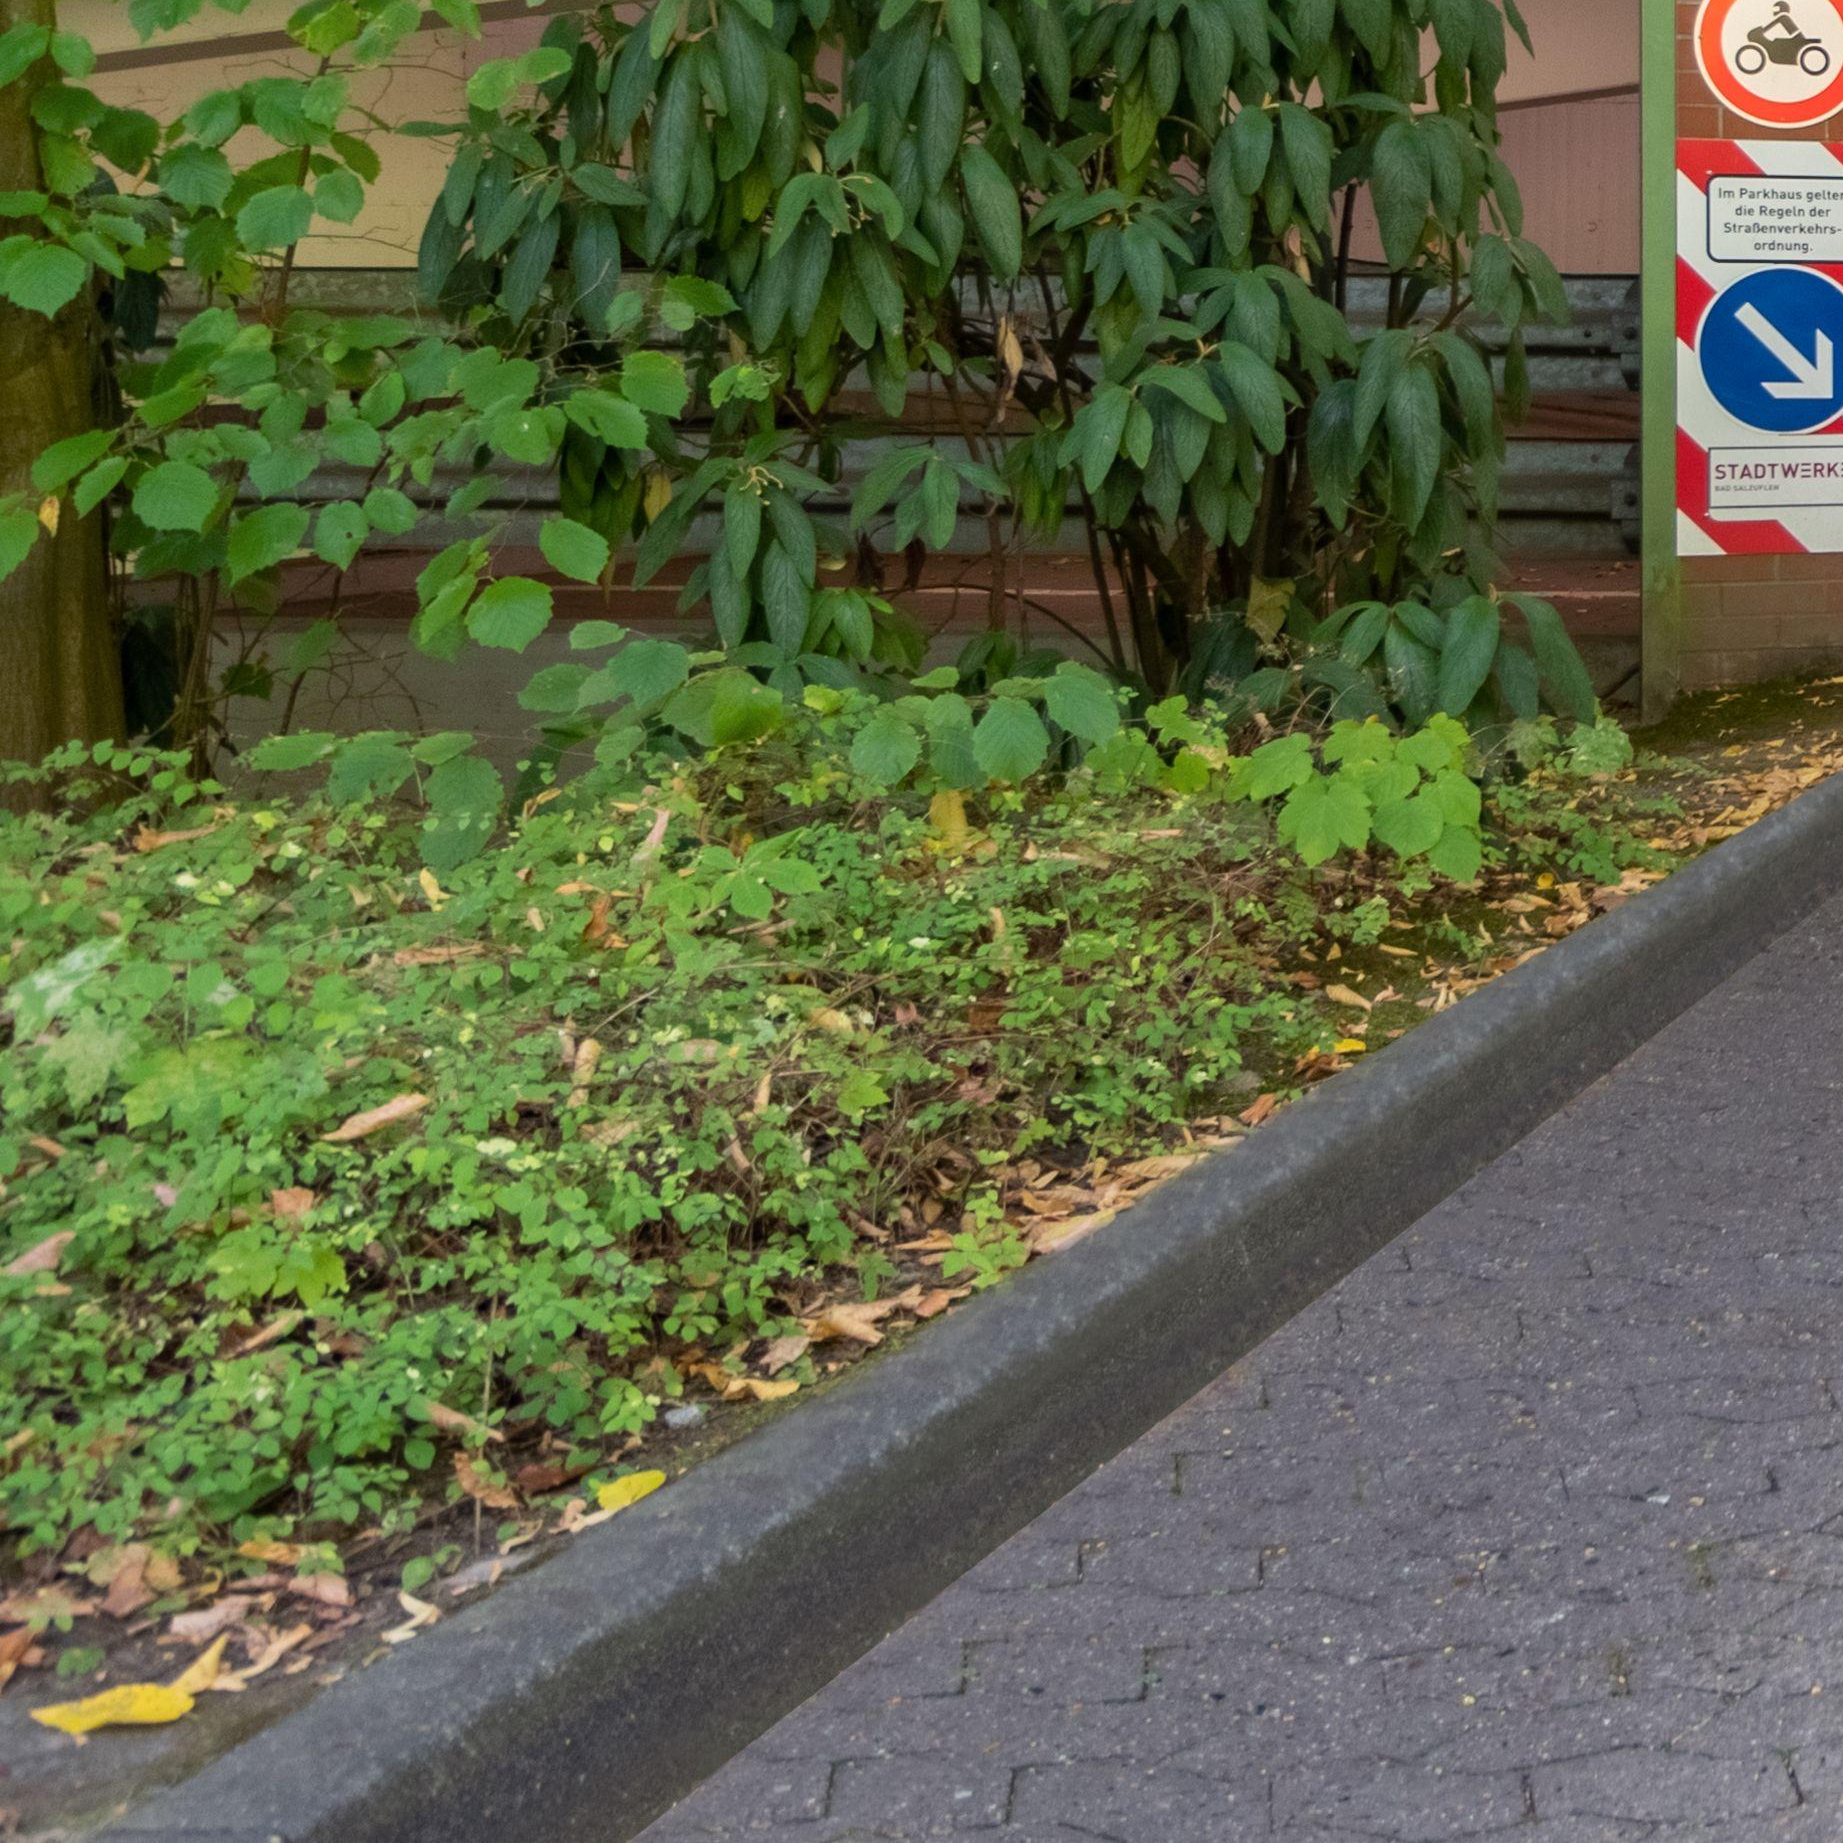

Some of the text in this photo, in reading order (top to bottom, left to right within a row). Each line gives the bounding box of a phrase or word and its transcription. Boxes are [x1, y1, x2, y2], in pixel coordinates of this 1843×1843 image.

[1718, 188, 1735, 199] Im
[1740, 188, 1802, 199] Parkhaus
[1735, 206, 1831, 219] die Regeln der
[1724, 223, 1842, 234] Straßenverkehrs-
[1754, 241, 1813, 253] ordnung.
